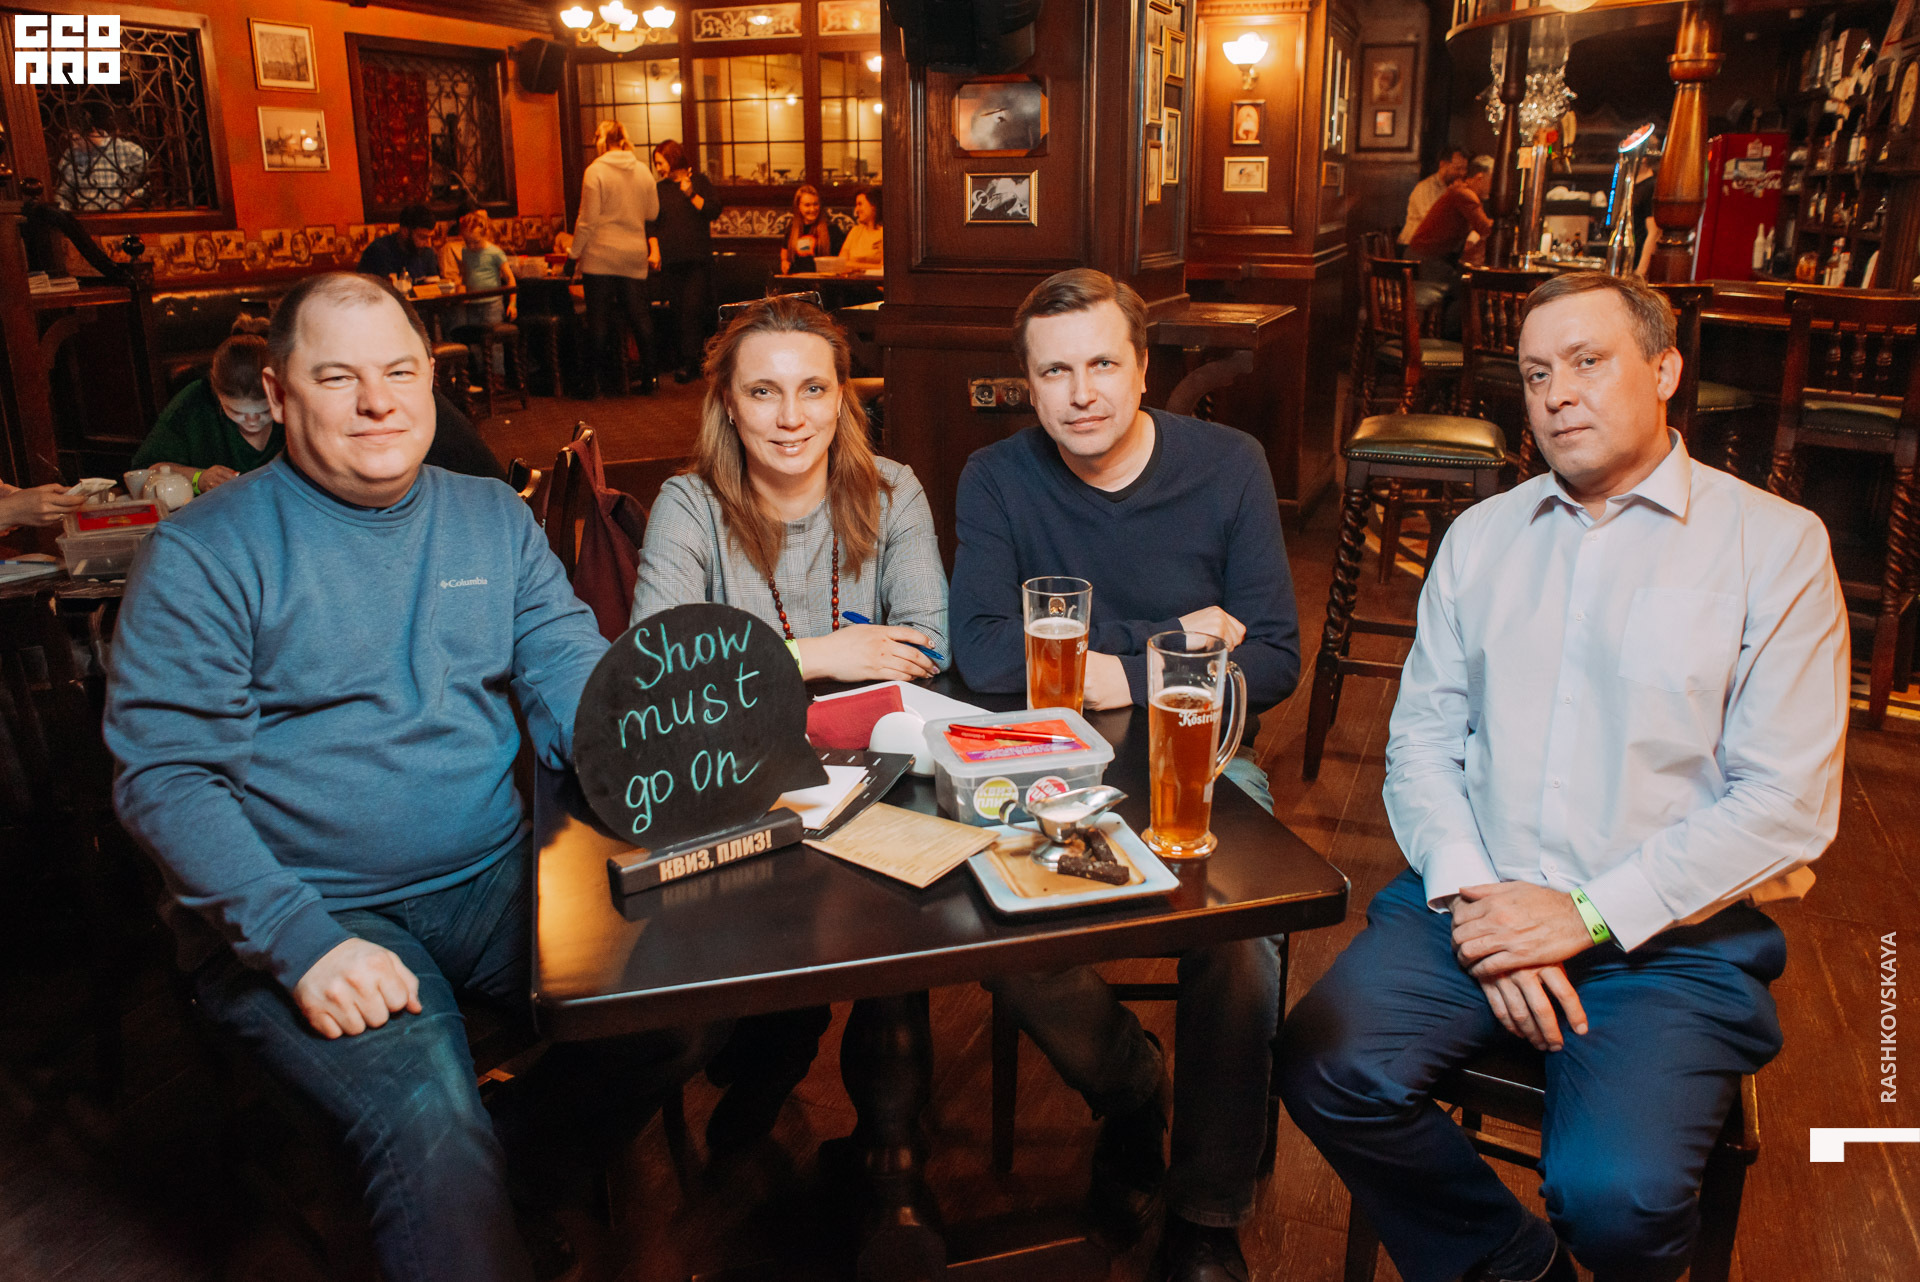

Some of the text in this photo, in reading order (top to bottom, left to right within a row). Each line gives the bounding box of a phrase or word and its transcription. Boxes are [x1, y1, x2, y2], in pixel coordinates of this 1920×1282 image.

[448, 576, 488, 588] Columbia
[634, 620, 752, 690] Show
[618, 662, 760, 749] must
[625, 769, 675, 834] go
[659, 829, 773, 883] КВИЗ, ПЛИЗ!
